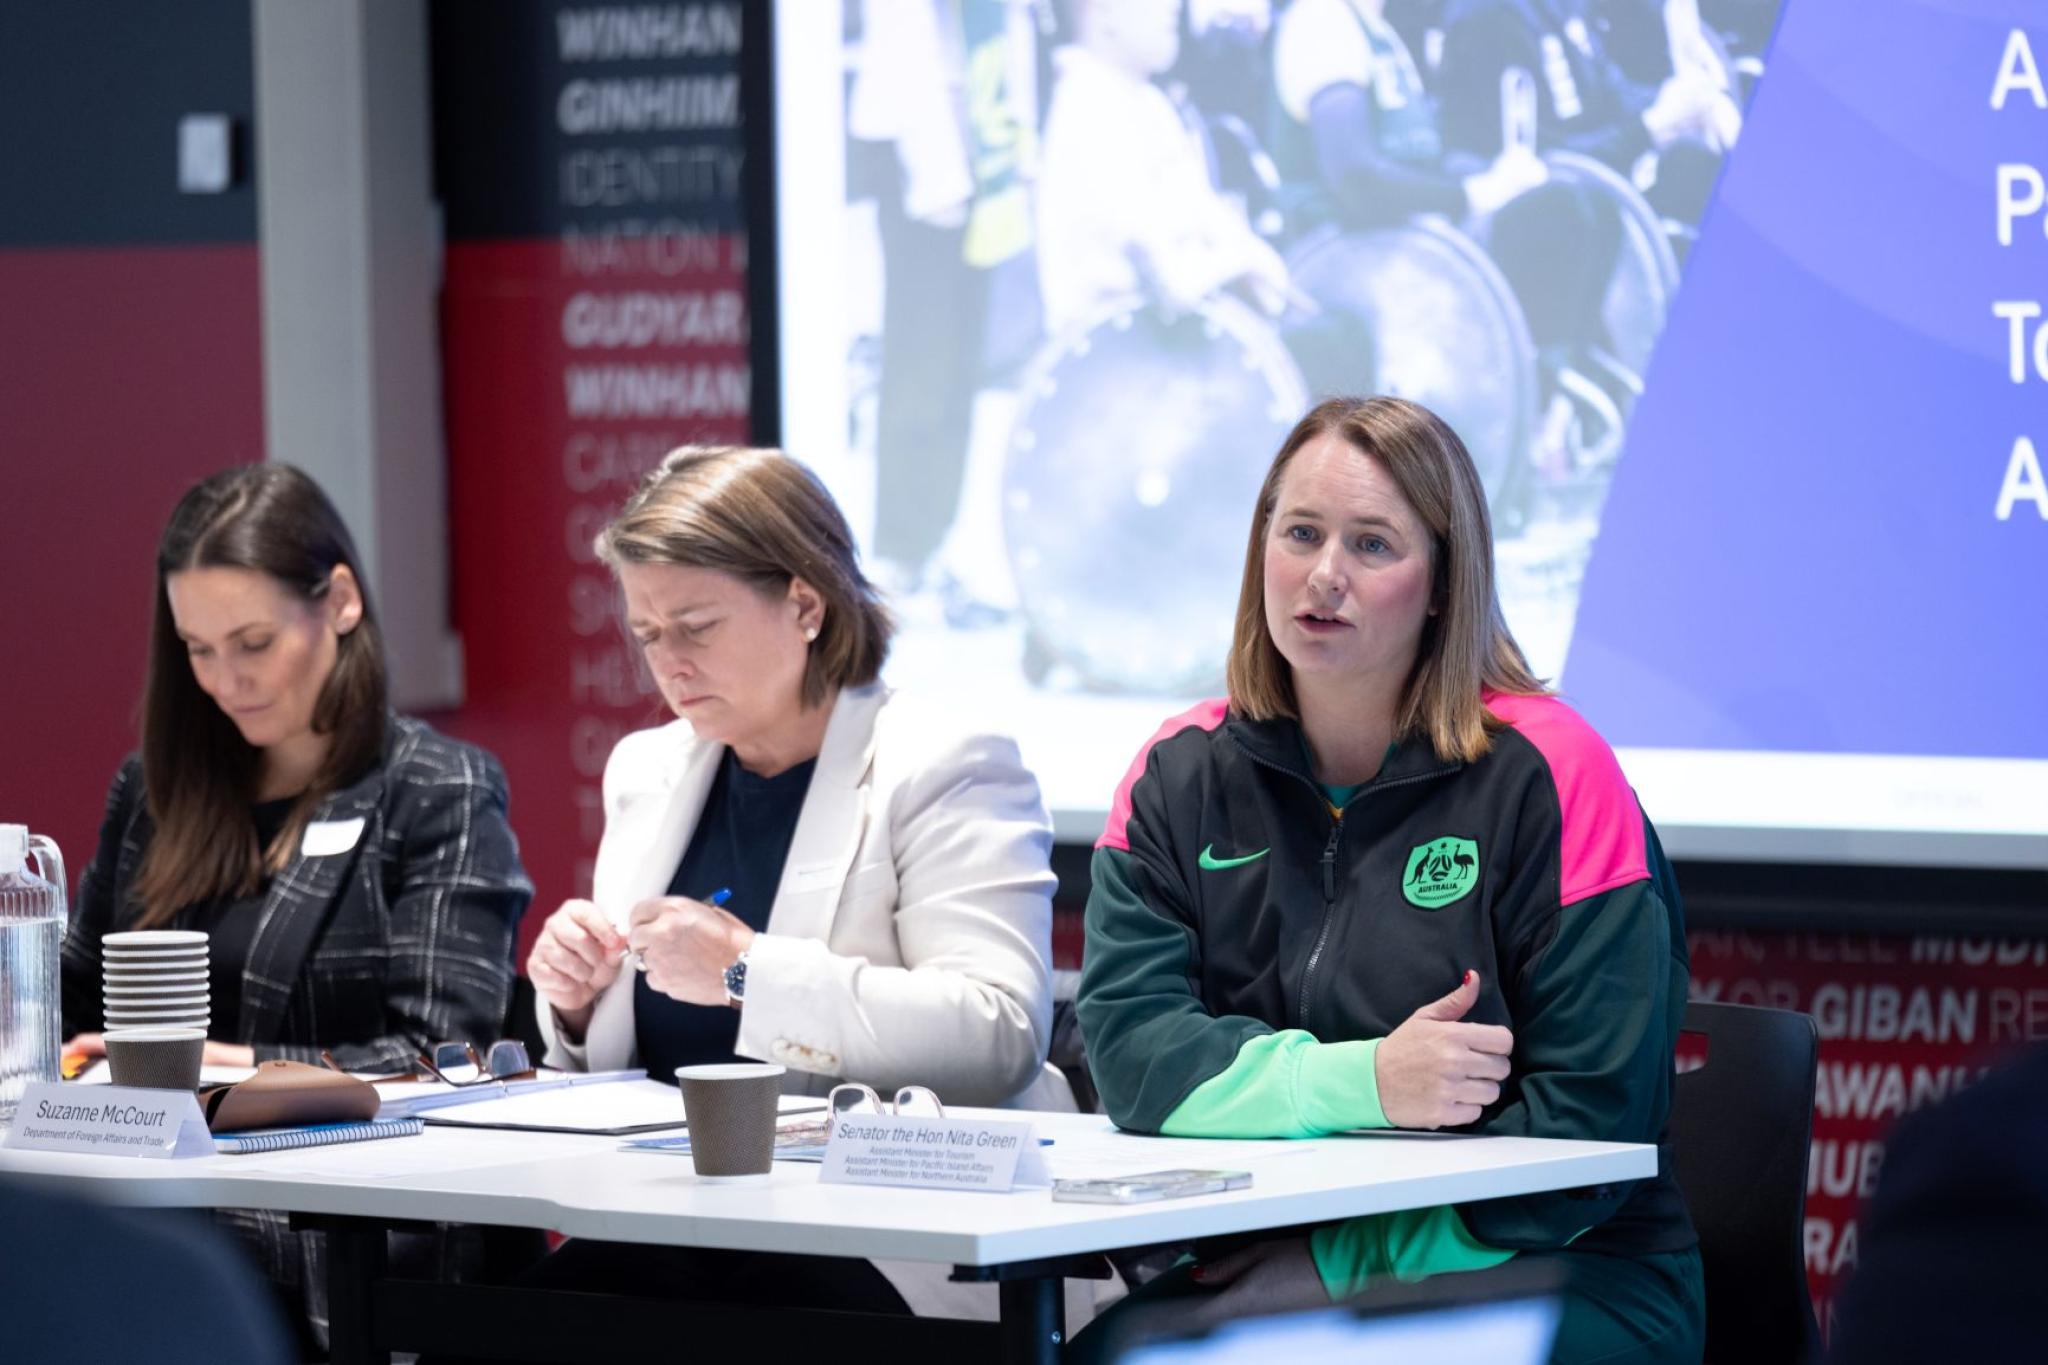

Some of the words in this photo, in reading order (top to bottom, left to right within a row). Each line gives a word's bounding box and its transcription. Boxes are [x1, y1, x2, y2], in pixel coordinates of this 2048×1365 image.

[1996, 162, 2048, 246] P
[1418, 882, 1458, 893] AUSTRALIA
[1811, 982, 1977, 1044] GIBAN
[36, 1099, 100, 1122] Suzanne
[101, 1103, 167, 1127] McCourt
[23, 1126, 67, 1139] Department
[67, 1130, 75, 1140] of
[75, 1130, 102, 1144] Foreign
[103, 1133, 127, 1145] Affairs
[127, 1135, 143, 1145] and
[143, 1136, 165, 1147] Trade
[838, 1123, 892, 1141] Senator
[892, 1127, 916, 1142] the
[917, 1128, 945, 1145] Hon
[946, 1130, 974, 1147] Nita
[976, 1131, 1017, 1149] Green
[869, 1146, 903, 1156] Assistant
[904, 1148, 933, 1158] Minister
[934, 1150, 945, 1159] for
[946, 1150, 976, 1161] Tourism
[845, 1155, 879, 1166] Assistant
[880, 1157, 909, 1168] Minister
[909, 1159, 921, 1169] for
[921, 1160, 946, 1171] Pacific
[947, 1162, 970, 1172] Island
[971, 1163, 995, 1174] Affairs
[845, 1166, 879, 1177] Assistant
[880, 1168, 909, 1179] Minister
[909, 1170, 921, 1180] for
[922, 1171, 954, 1182] Northern
[955, 1173, 988, 1184] Australia
